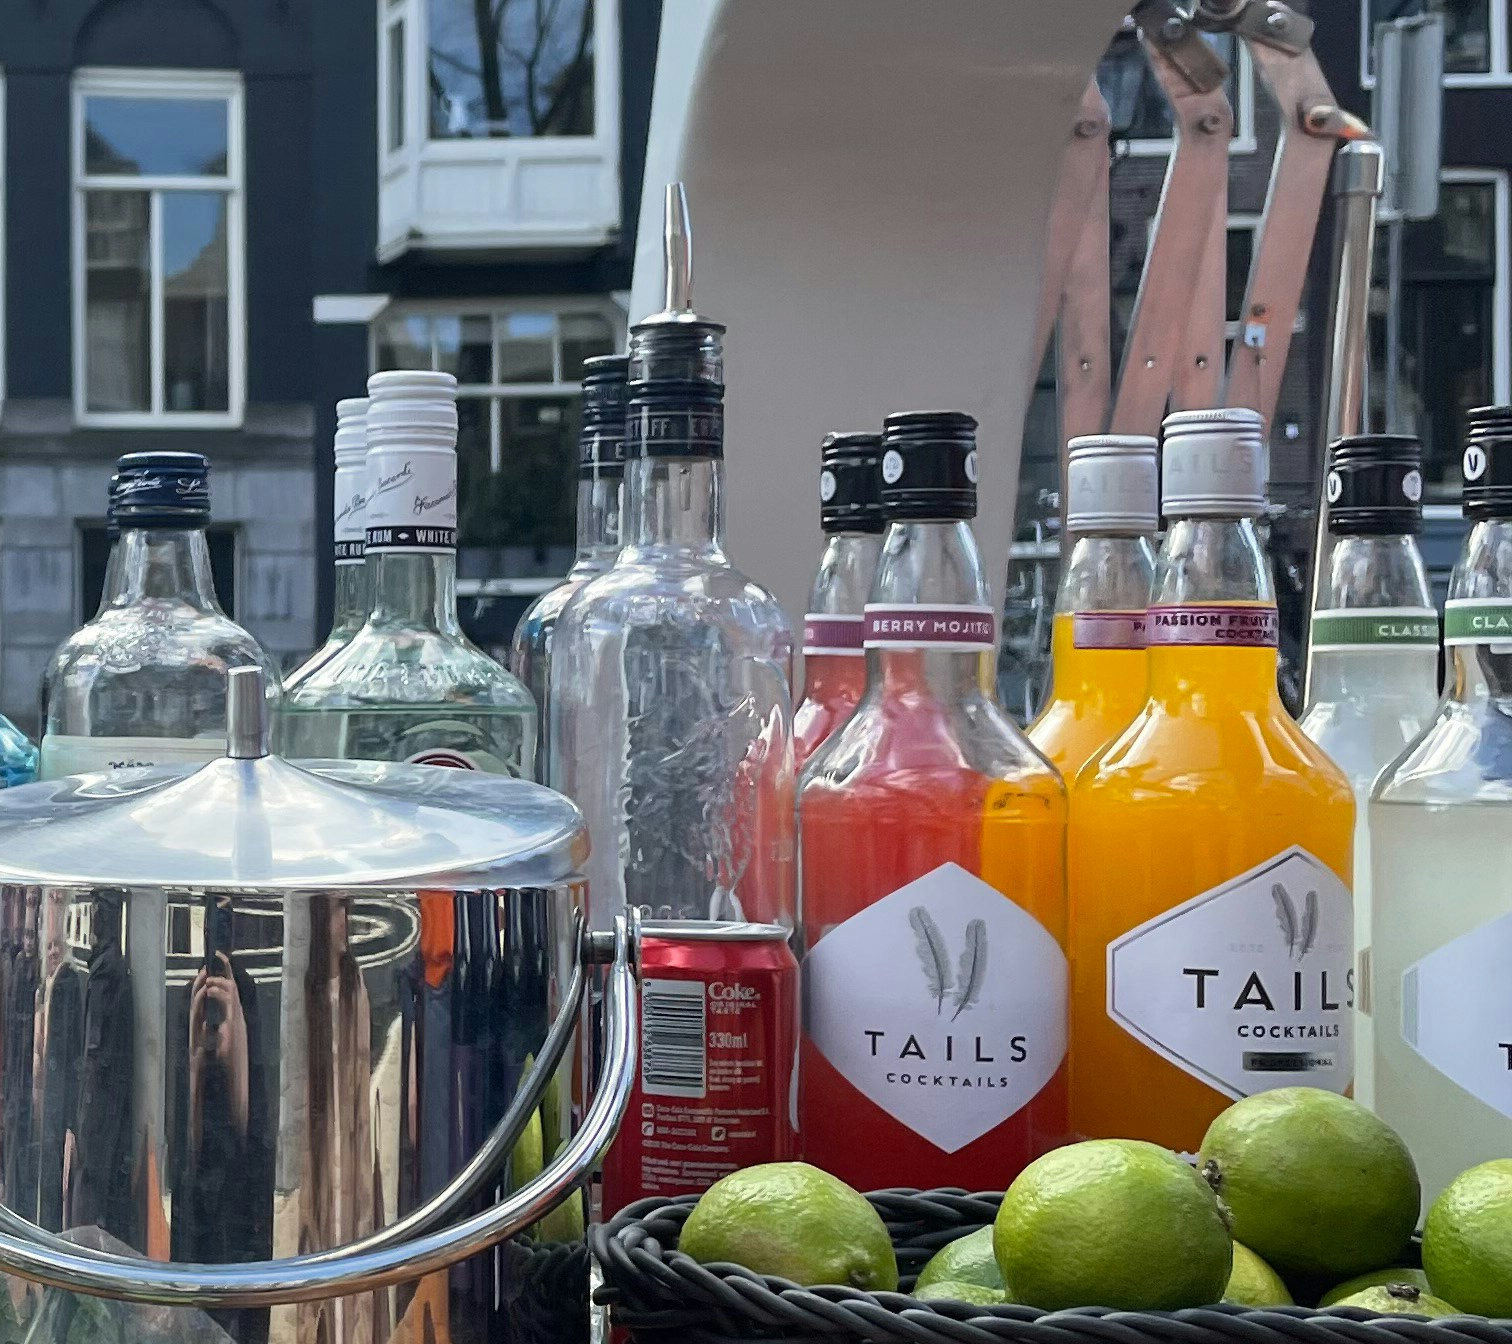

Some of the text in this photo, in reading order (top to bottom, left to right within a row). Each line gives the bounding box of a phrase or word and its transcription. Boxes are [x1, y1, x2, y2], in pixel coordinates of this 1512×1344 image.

[415, 529, 450, 543] WHITE
[872, 619, 927, 634] BERRY
[1155, 614, 1222, 627] PASSION
[1228, 615, 1269, 628] FRUIT
[1472, 616, 1512, 629] CLA
[708, 980, 757, 1001] Coke
[1236, 1024, 1340, 1039] COCKTAILS
[708, 1031, 749, 1050] 330ml
[864, 1030, 1027, 1063] TAILS
[886, 1072, 1009, 1088] COCKTAILS
